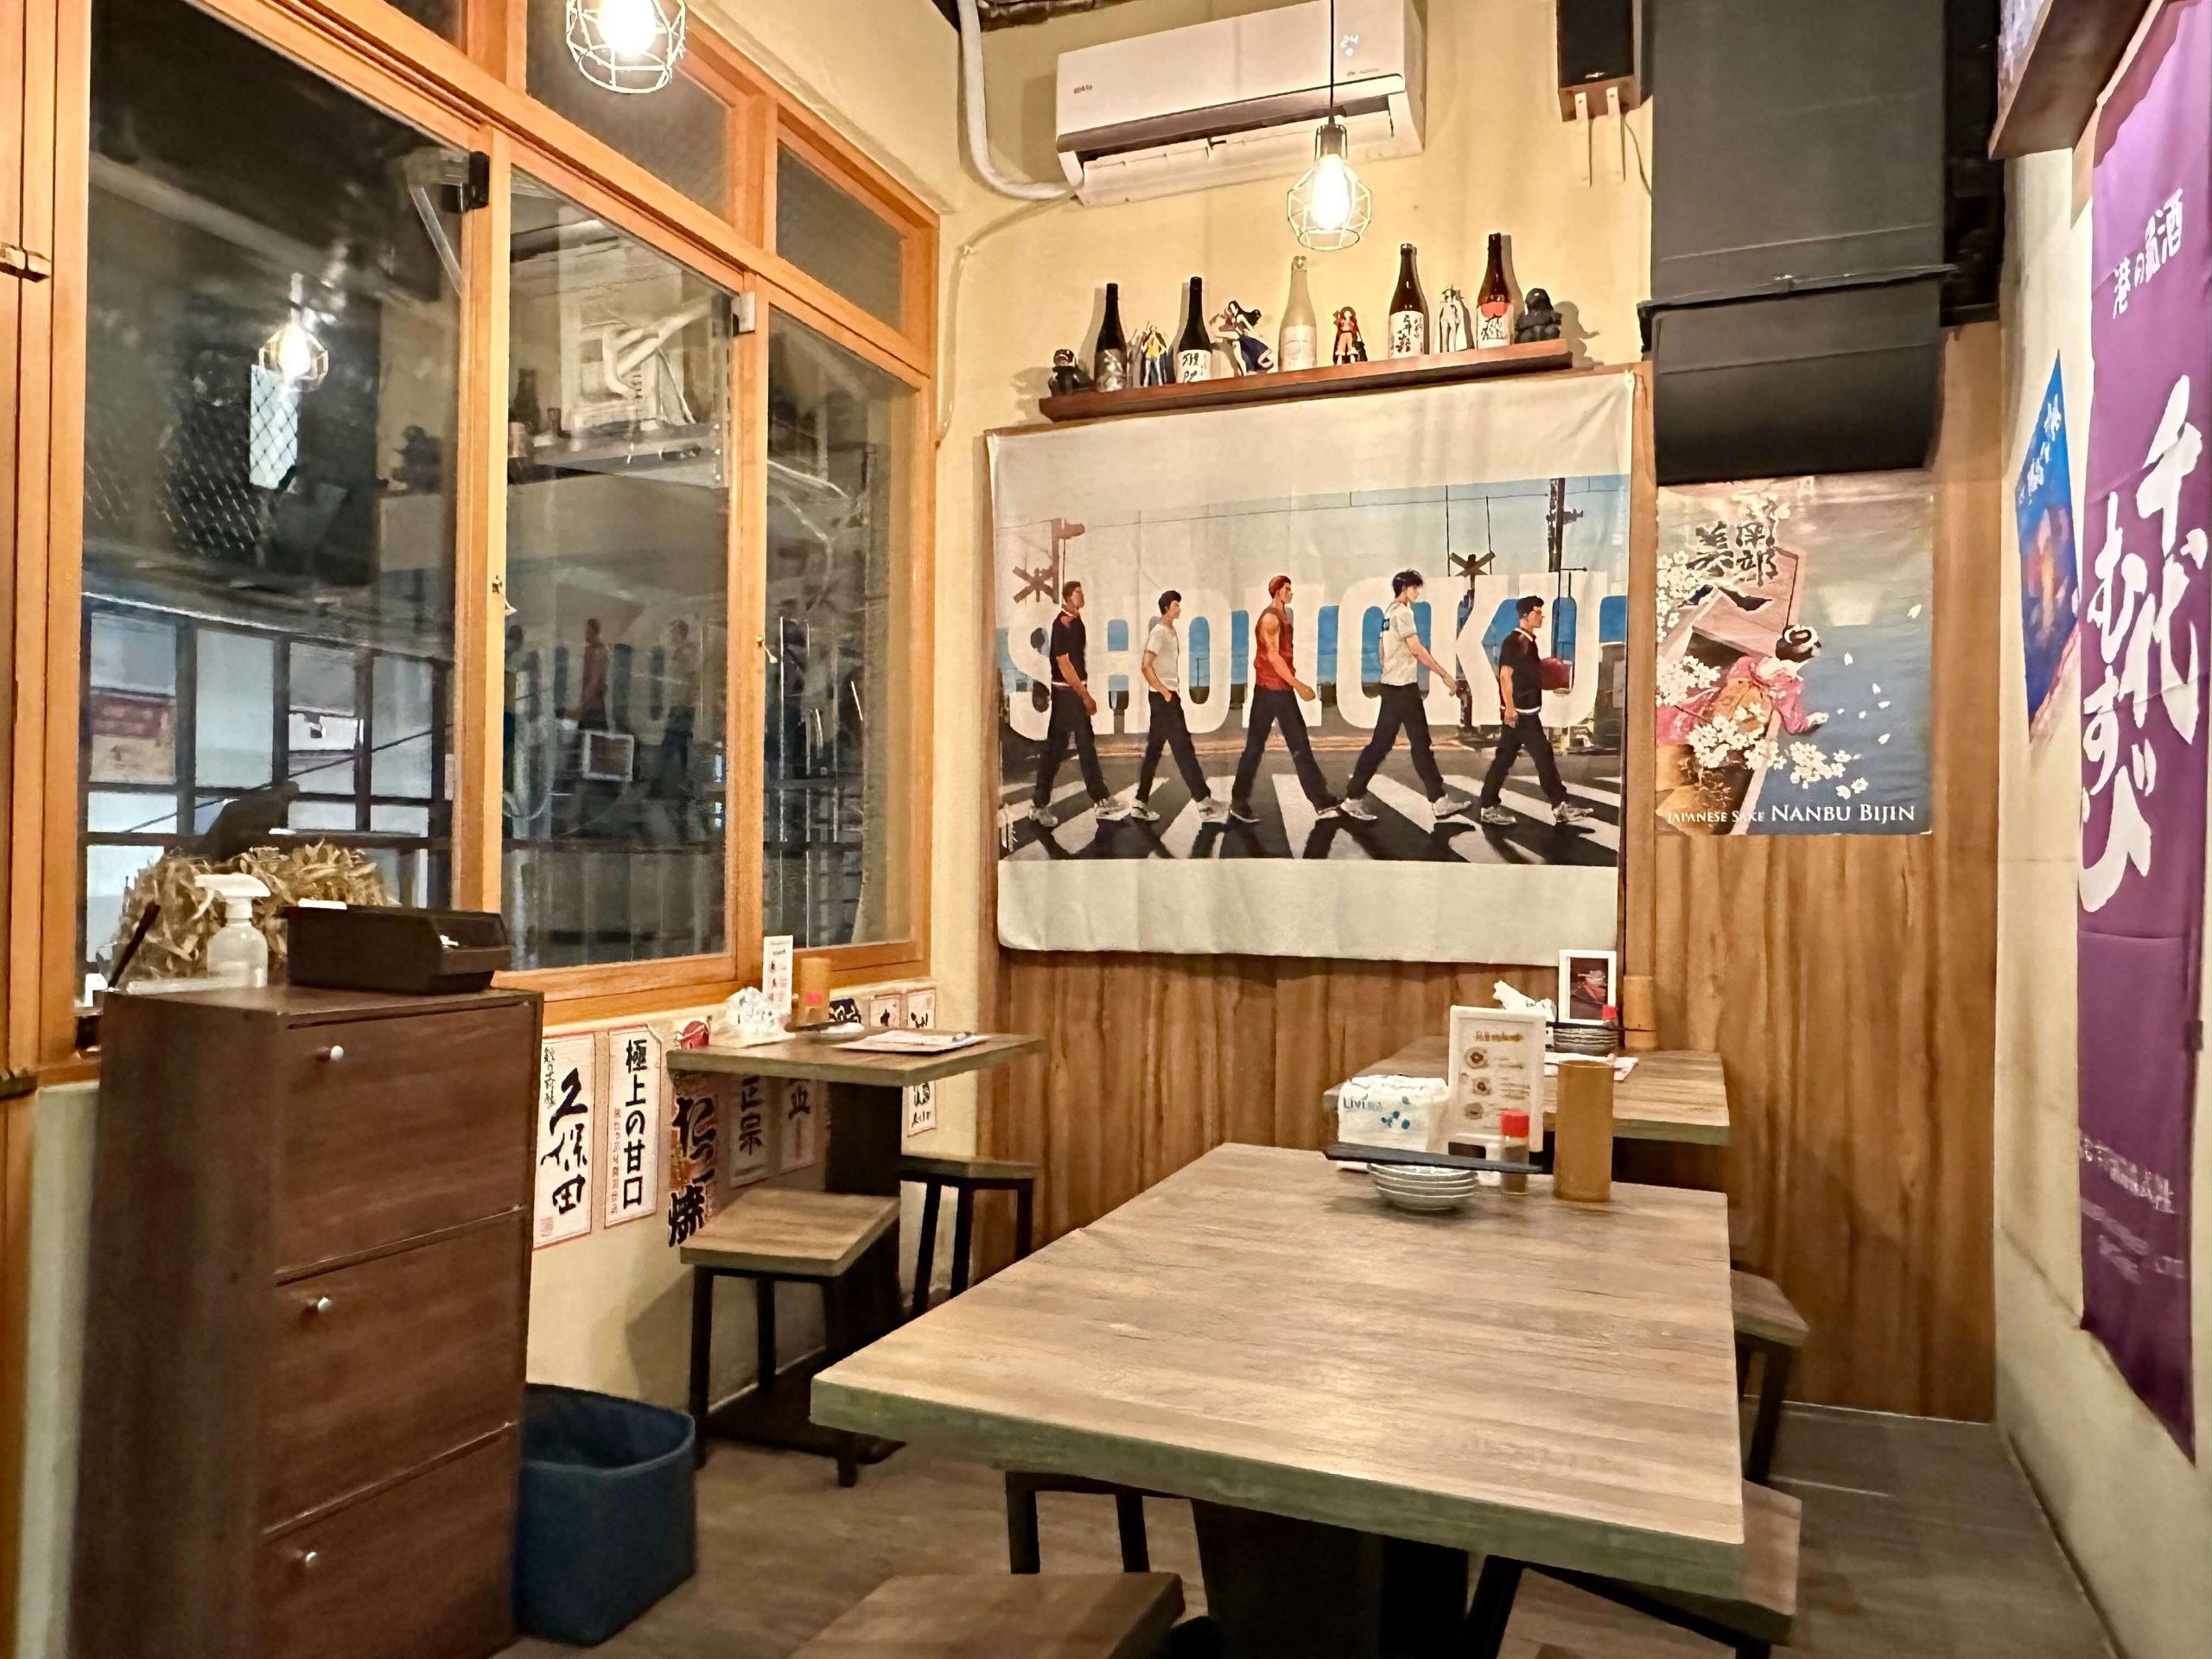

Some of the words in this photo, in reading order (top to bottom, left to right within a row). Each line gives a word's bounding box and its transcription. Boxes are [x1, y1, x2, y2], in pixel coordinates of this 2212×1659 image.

[1771, 804, 1851, 823] NANBU
[1859, 804, 1916, 824] BIJIN
[541, 1067, 588, 1215] 久保田
[623, 1039, 648, 1210] 極上の甘口
